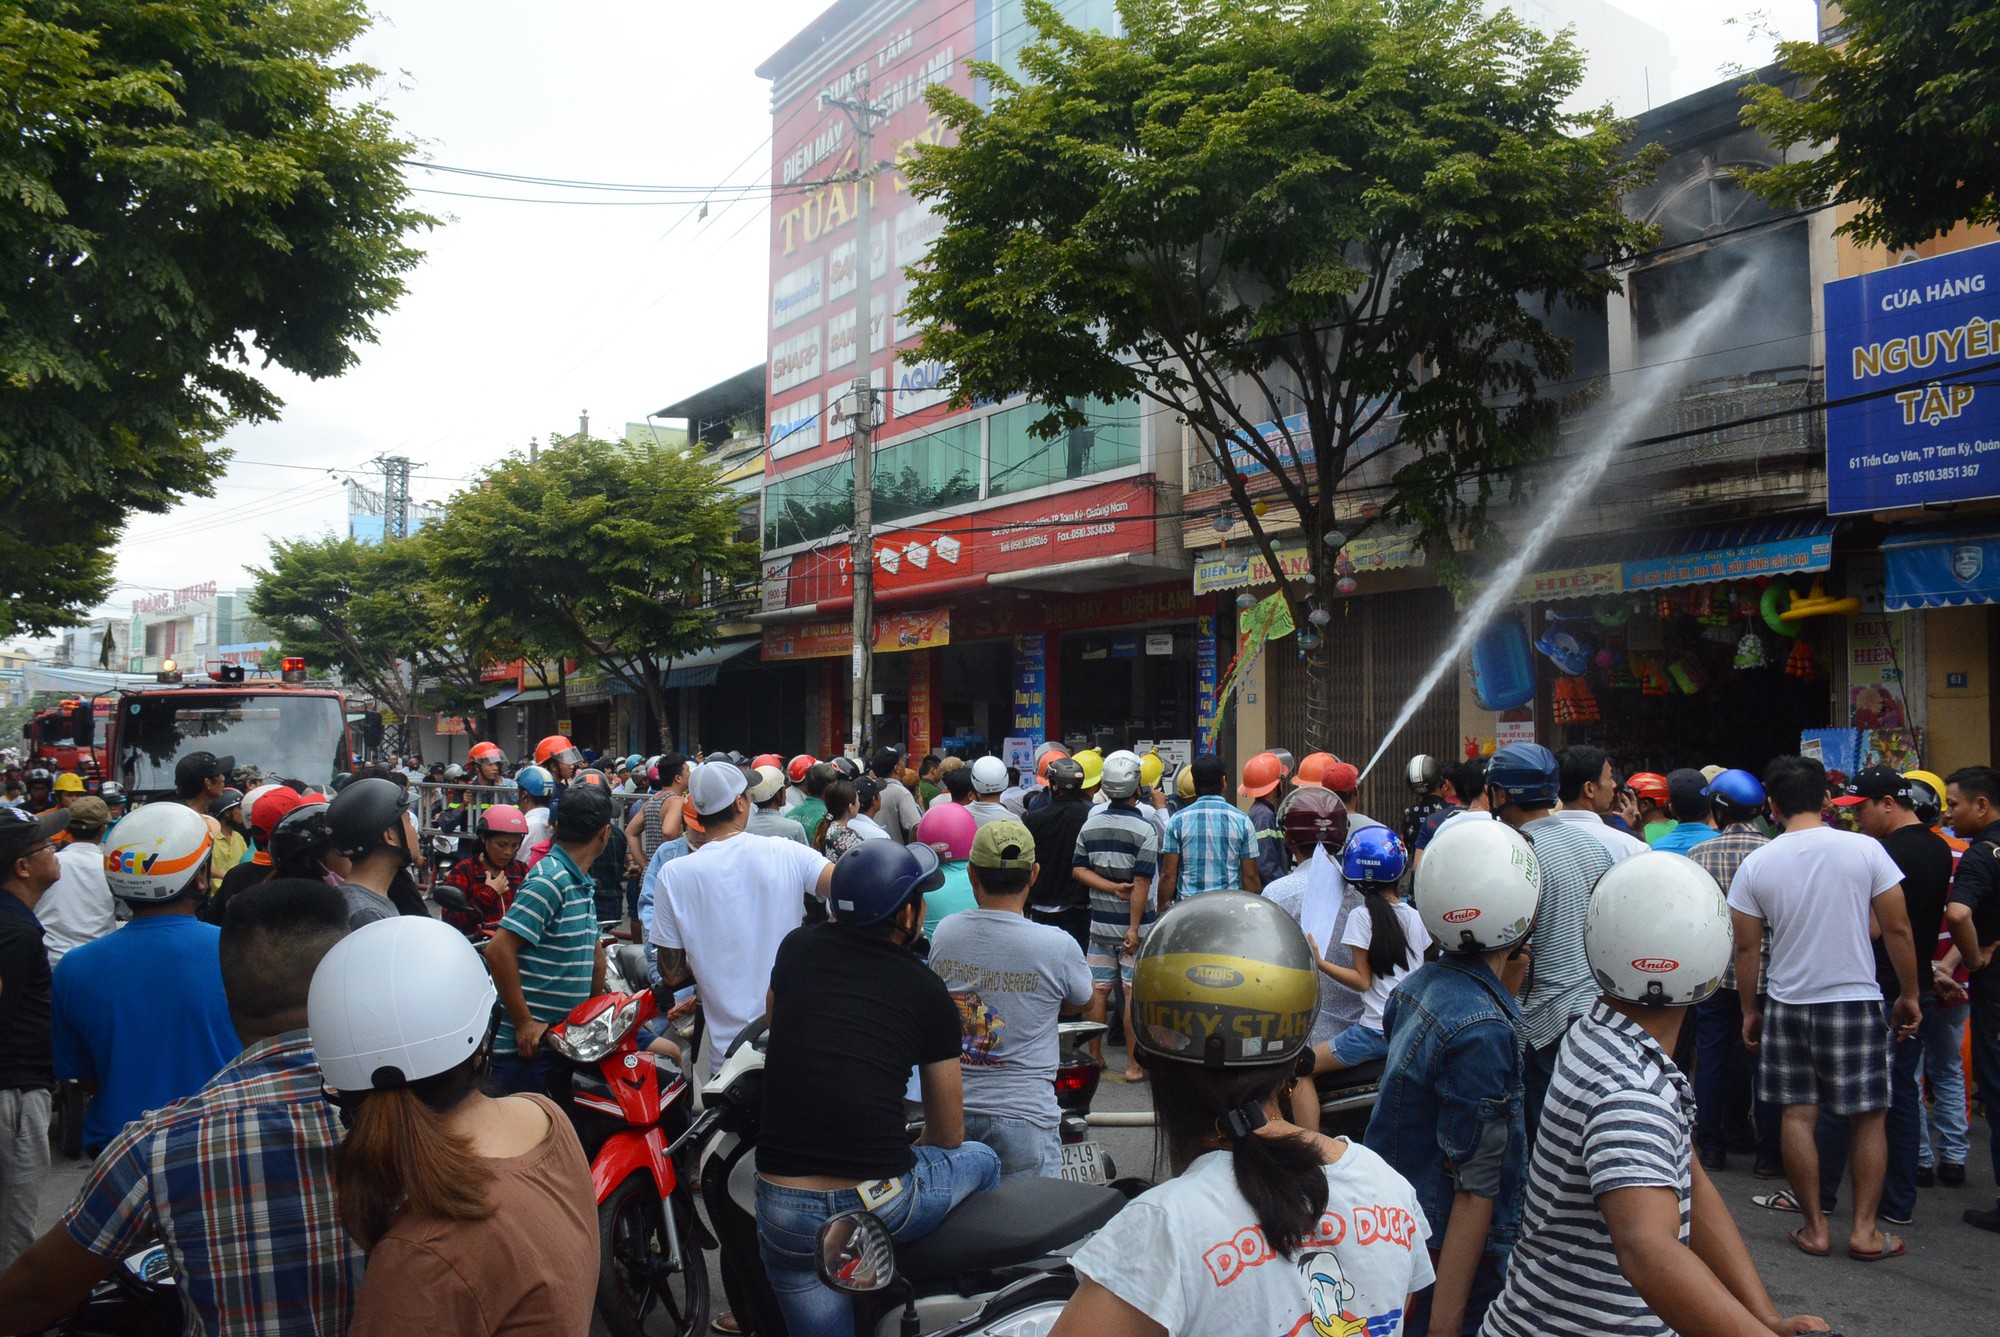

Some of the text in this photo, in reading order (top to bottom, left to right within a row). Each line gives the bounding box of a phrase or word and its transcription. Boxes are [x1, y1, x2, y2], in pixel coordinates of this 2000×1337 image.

[876, 28, 913, 68] TÂM
[1881, 274, 1986, 312] CỬA HÀNG
[773, 342, 819, 380] SHARP
[1895, 381, 1975, 426] TẬP
[1849, 457, 1860, 469] 61
[1882, 453, 1899, 465] Cao
[1923, 447, 1935, 459] TP
[1936, 445, 1956, 457] Tam
[1895, 464, 1980, 485] ĐT: 0510.3851 367
[1060, 511, 1074, 523] Tam
[1110, 501, 1129, 514] Nam
[1200, 562, 1229, 580] ĐIỆN
[1788, 551, 1810, 568] LOẠI
[1854, 620, 1893, 638] HUY
[1949, 674, 1962, 684] 61
[109, 849, 160, 876] SCTV
[1361, 859, 1381, 867] YAMAHA
[981, 968, 1001, 992] WHO
[1002, 971, 1040, 993] SERVED
[1353, 1204, 1417, 1251] DUCK
